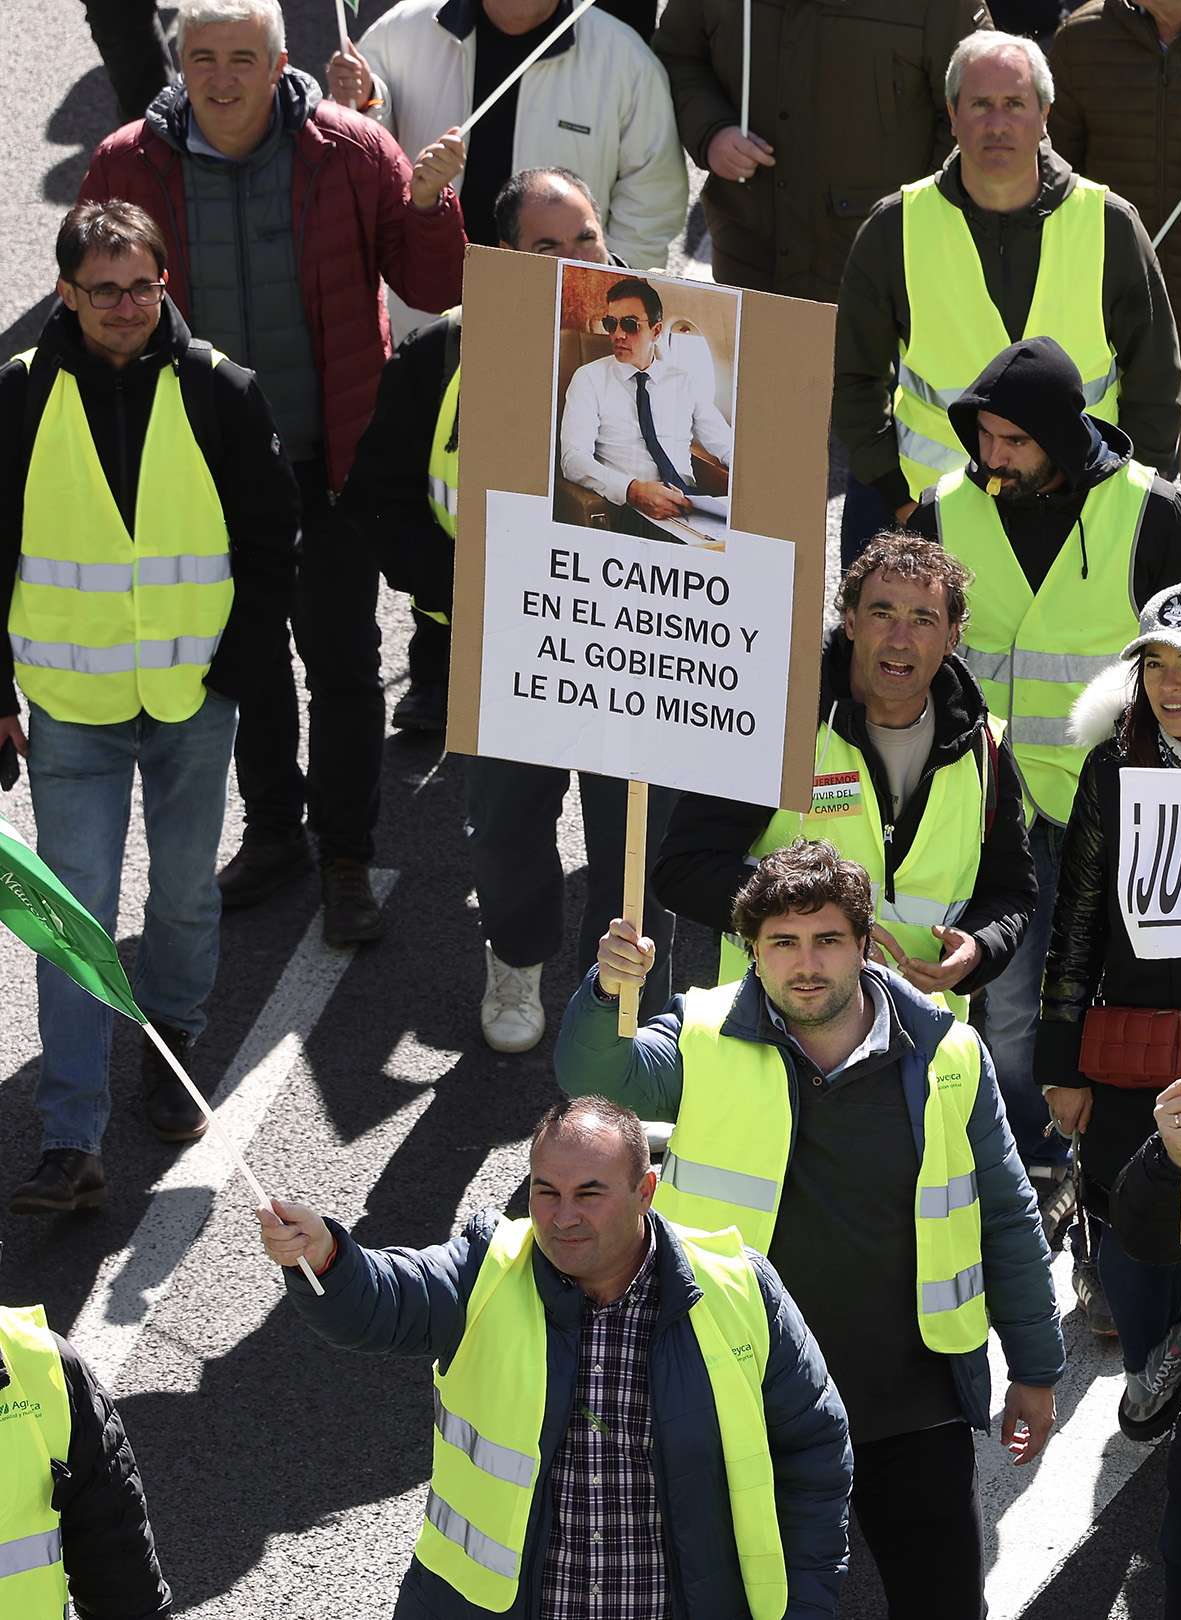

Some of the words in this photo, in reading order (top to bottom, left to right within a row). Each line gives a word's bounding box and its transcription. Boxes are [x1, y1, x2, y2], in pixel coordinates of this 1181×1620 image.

[550, 548, 590, 584] EL
[601, 557, 730, 606] CAMPO
[523, 590, 561, 620] EN
[572, 598, 606, 627] EL
[614, 606, 731, 648] ABISMO
[740, 627, 759, 653] Y
[537, 635, 575, 664] AL
[584, 642, 739, 691] GOBIERNO
[513, 671, 548, 701] LE
[557, 678, 599, 709] DA
[608, 687, 645, 716] LO
[655, 695, 756, 736] MISMO
[814, 802, 850, 814] CAMPO
[836, 788, 853, 799] DEL
